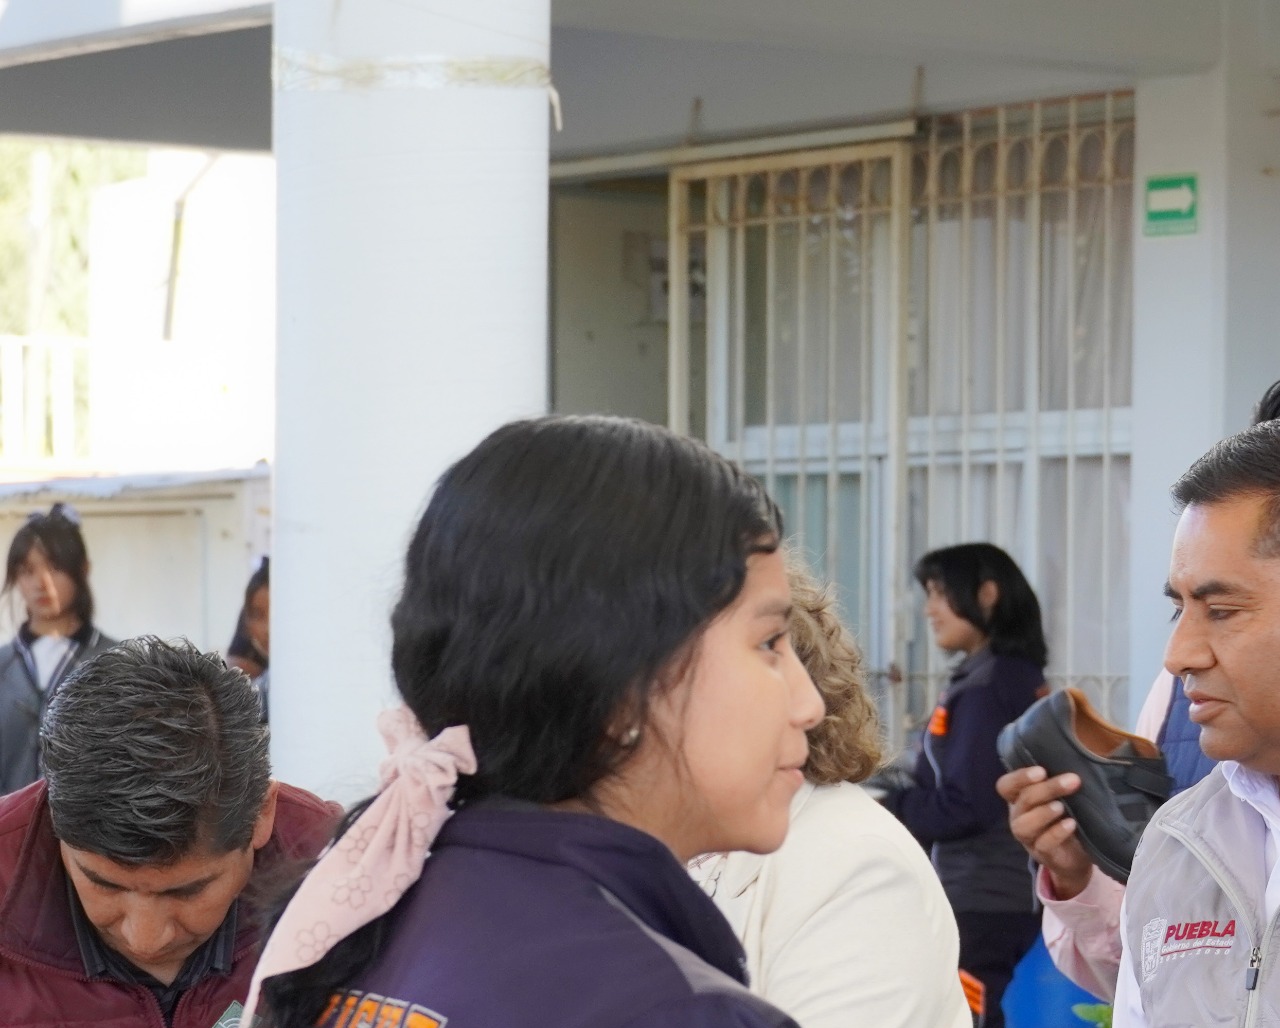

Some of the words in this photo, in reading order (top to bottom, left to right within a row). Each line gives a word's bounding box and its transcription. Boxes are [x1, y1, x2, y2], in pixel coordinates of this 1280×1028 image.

[1163, 919, 1236, 944] PUEBLA
[1161, 942, 1191, 953] Gobierno
[1193, 938, 1205, 947] del
[1205, 938, 1234, 947] Estado
